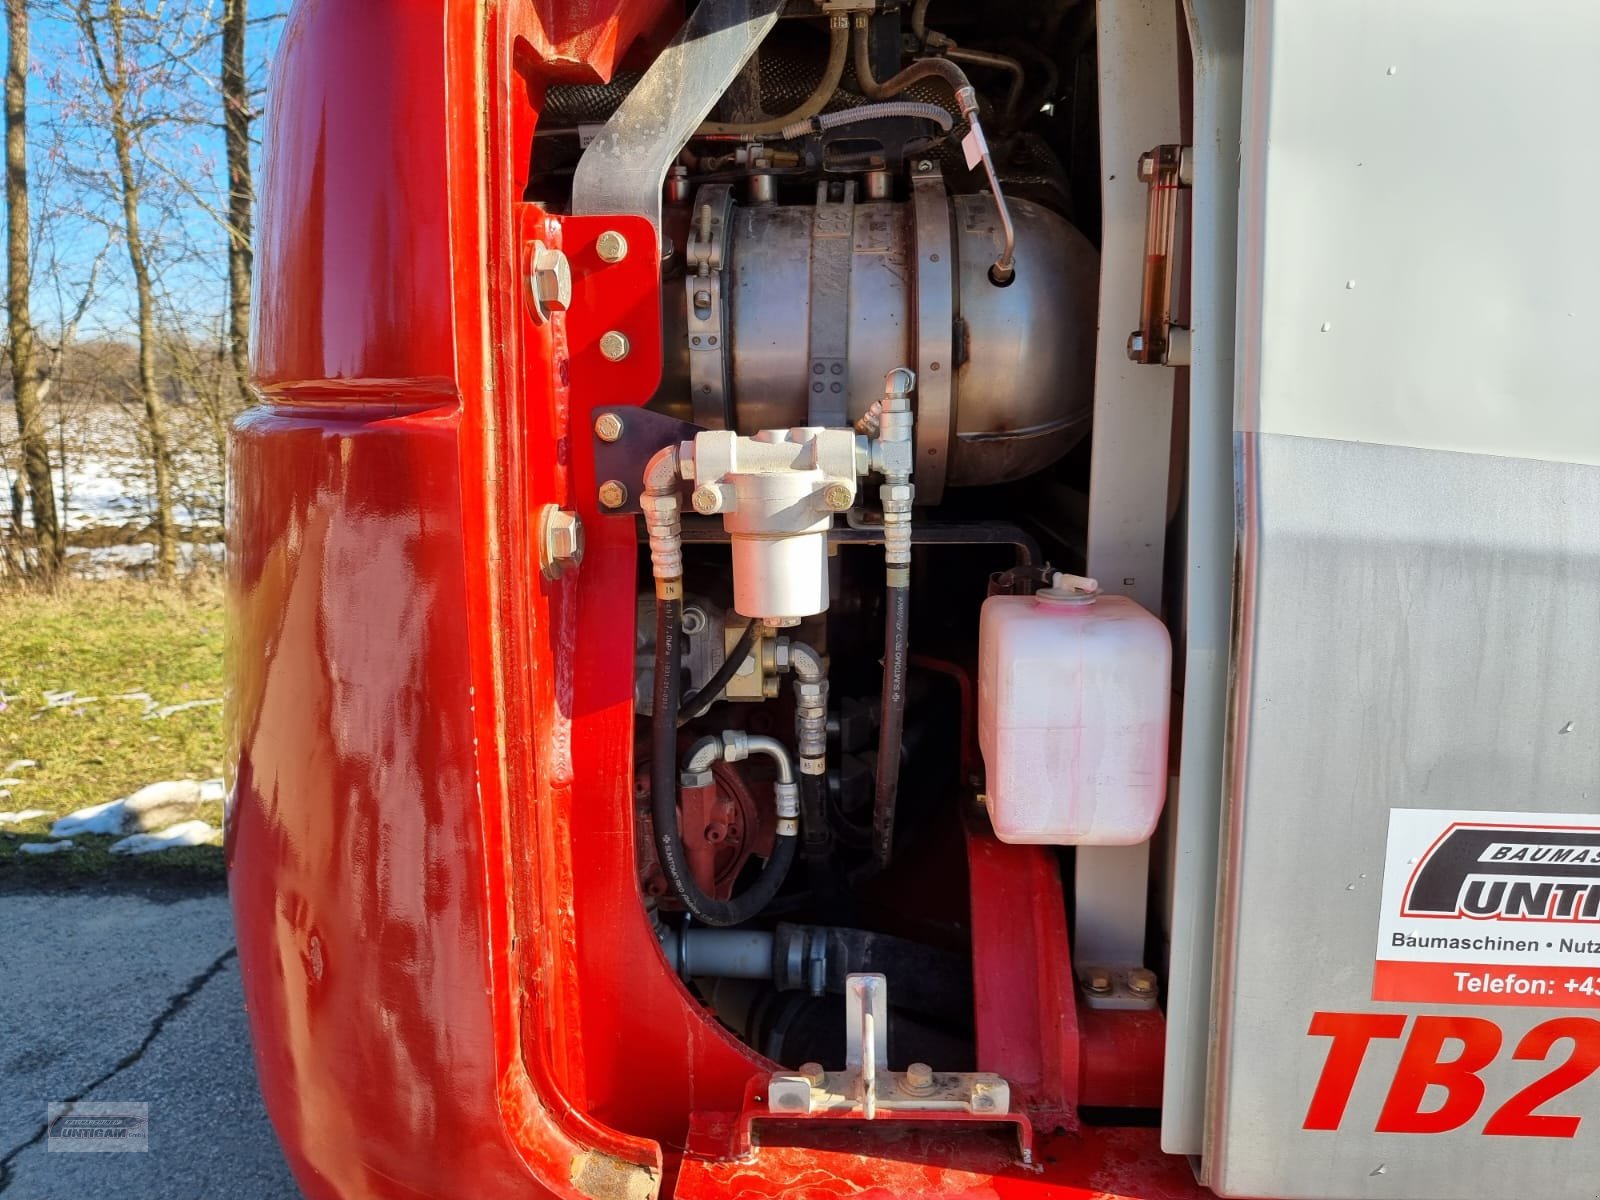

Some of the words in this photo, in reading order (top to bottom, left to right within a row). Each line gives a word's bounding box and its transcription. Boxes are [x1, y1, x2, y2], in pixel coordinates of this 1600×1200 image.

[665, 586, 675, 594] IN
[1463, 880, 1600, 917] UNTI
[1391, 932, 1539, 952] Baumaschinen
[1559, 938, 1600, 954] Nutz
[1453, 972, 1555, 995] Telefon:
[1302, 1011, 1600, 1139] TB2
